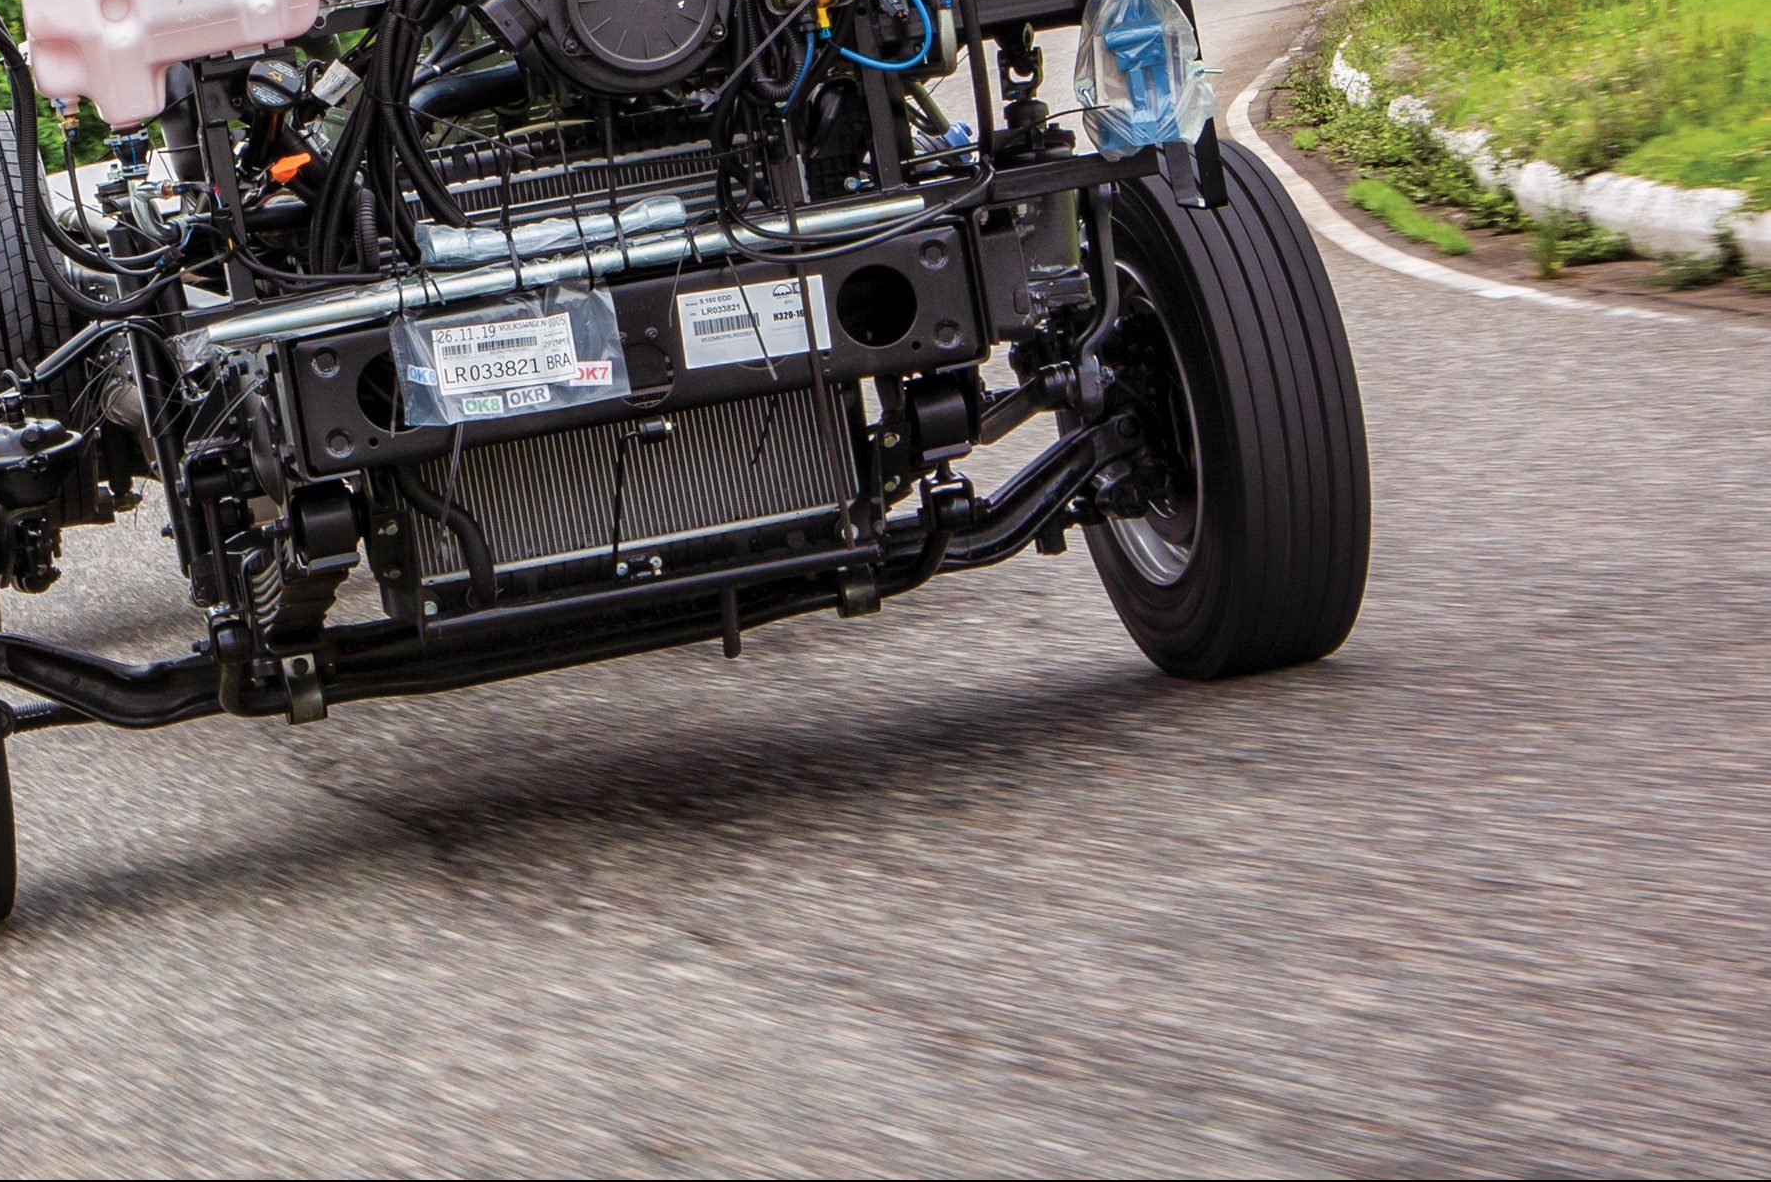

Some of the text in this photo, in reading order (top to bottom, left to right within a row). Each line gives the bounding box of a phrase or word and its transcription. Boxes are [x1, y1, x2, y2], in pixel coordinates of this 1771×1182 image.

[701, 303, 741, 316] LR033821
[437, 325, 496, 343] 26.11.19
[499, 320, 547, 332] VOLKSWAGEN
[546, 353, 572, 371] BRA
[465, 398, 501, 413] OK8
[510, 387, 547, 406] OKR
